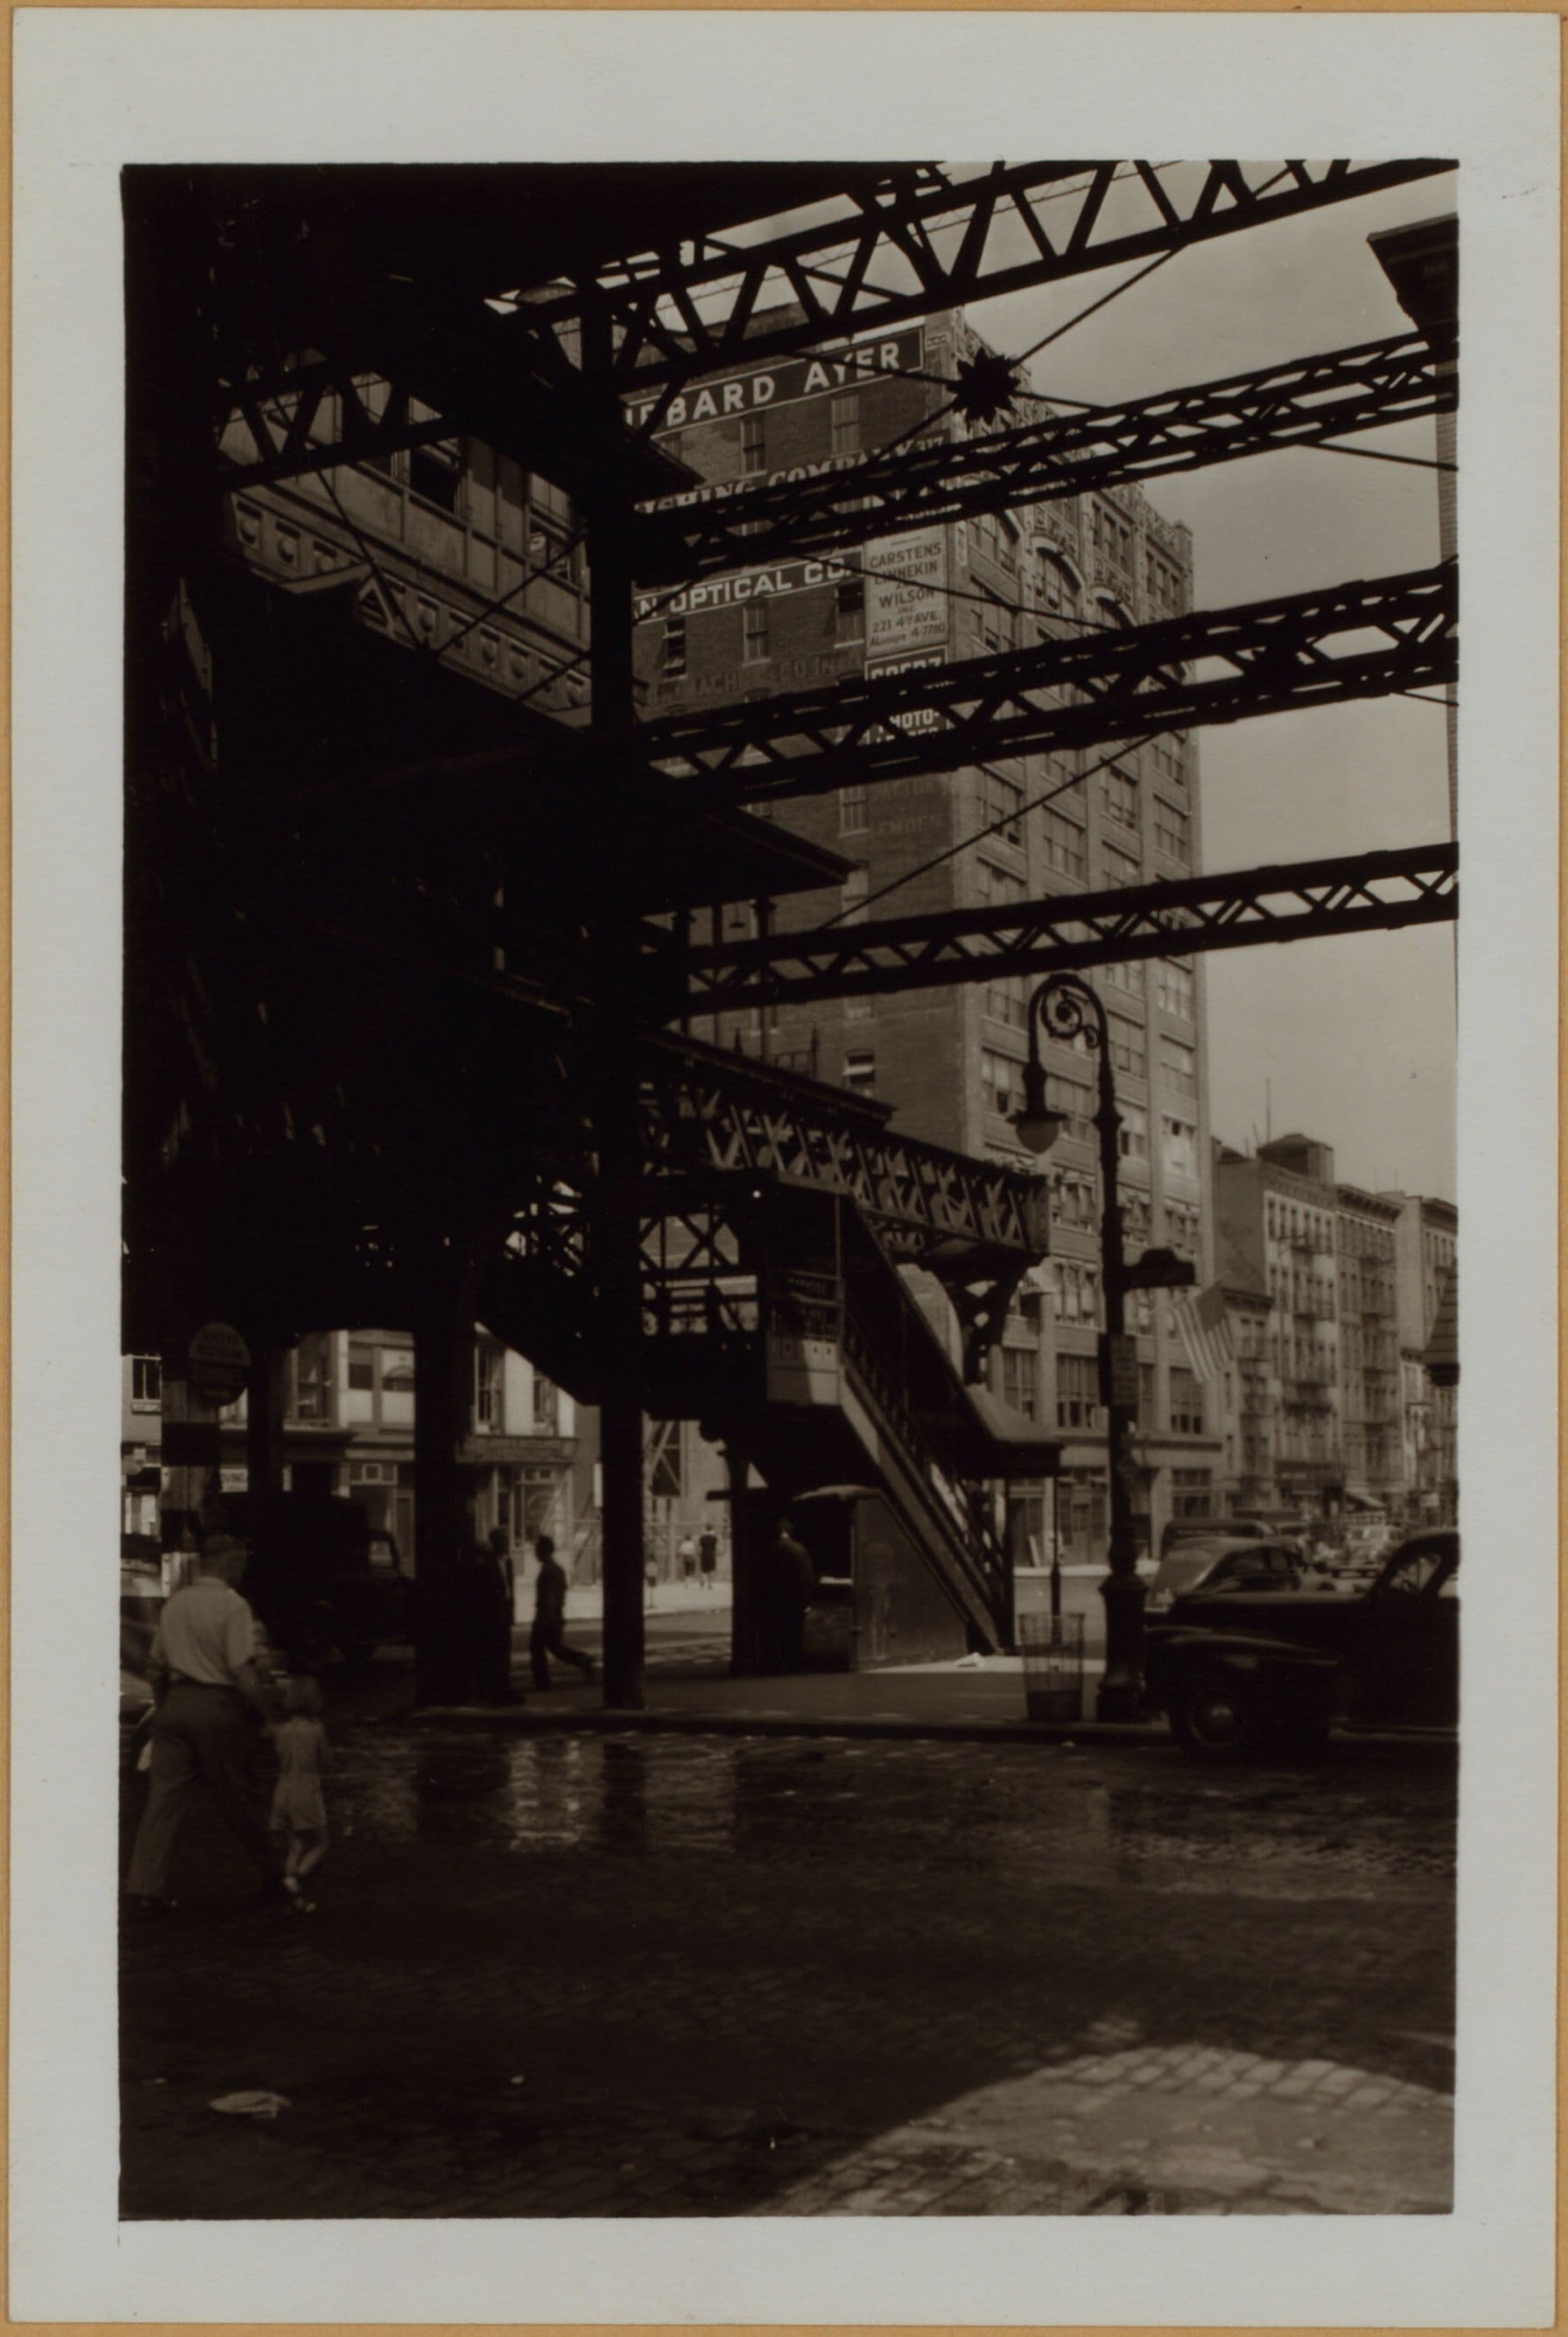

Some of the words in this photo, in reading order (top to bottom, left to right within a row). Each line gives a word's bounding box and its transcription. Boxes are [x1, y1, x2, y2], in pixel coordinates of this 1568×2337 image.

[803, 340, 901, 393] AYER
[870, 542, 942, 568] CARSTENS
[669, 570, 793, 614] OPTICAL
[803, 557, 852, 585] CO.
[879, 587, 934, 609] WILSON
[872, 619, 891, 633] 221
